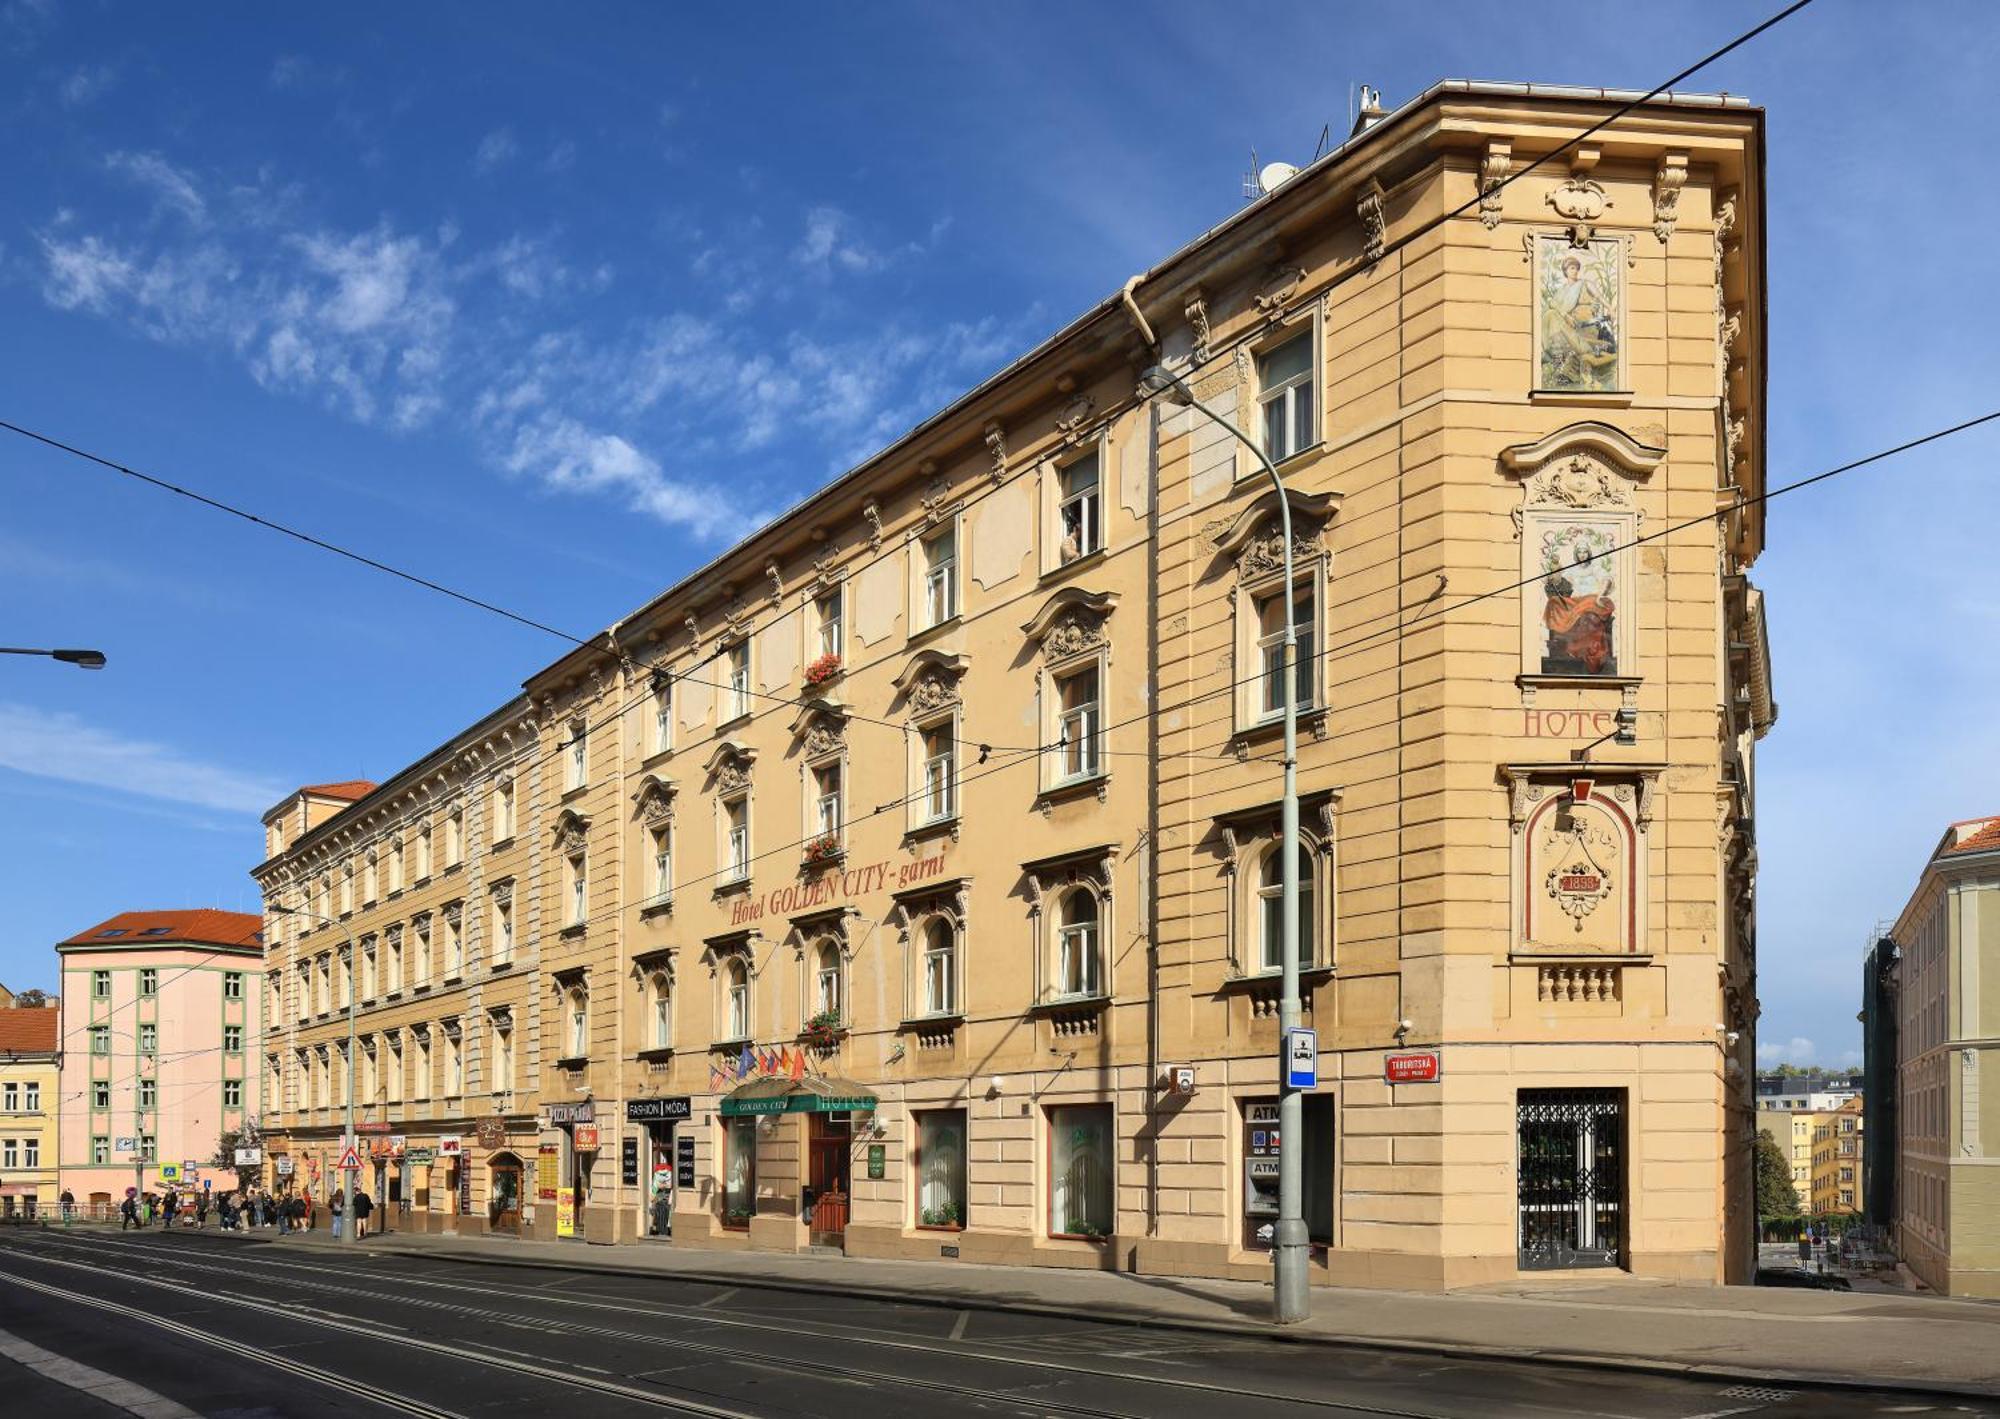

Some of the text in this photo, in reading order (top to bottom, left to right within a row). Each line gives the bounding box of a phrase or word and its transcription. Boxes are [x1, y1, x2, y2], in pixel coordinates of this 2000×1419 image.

[1524, 711, 1612, 737] HOTE
[731, 894, 765, 926] Hotel
[769, 876, 840, 916] GOLDEN
[629, 1101, 688, 1116] FASHION MÓDA
[1255, 1163, 1279, 1173] ATM
